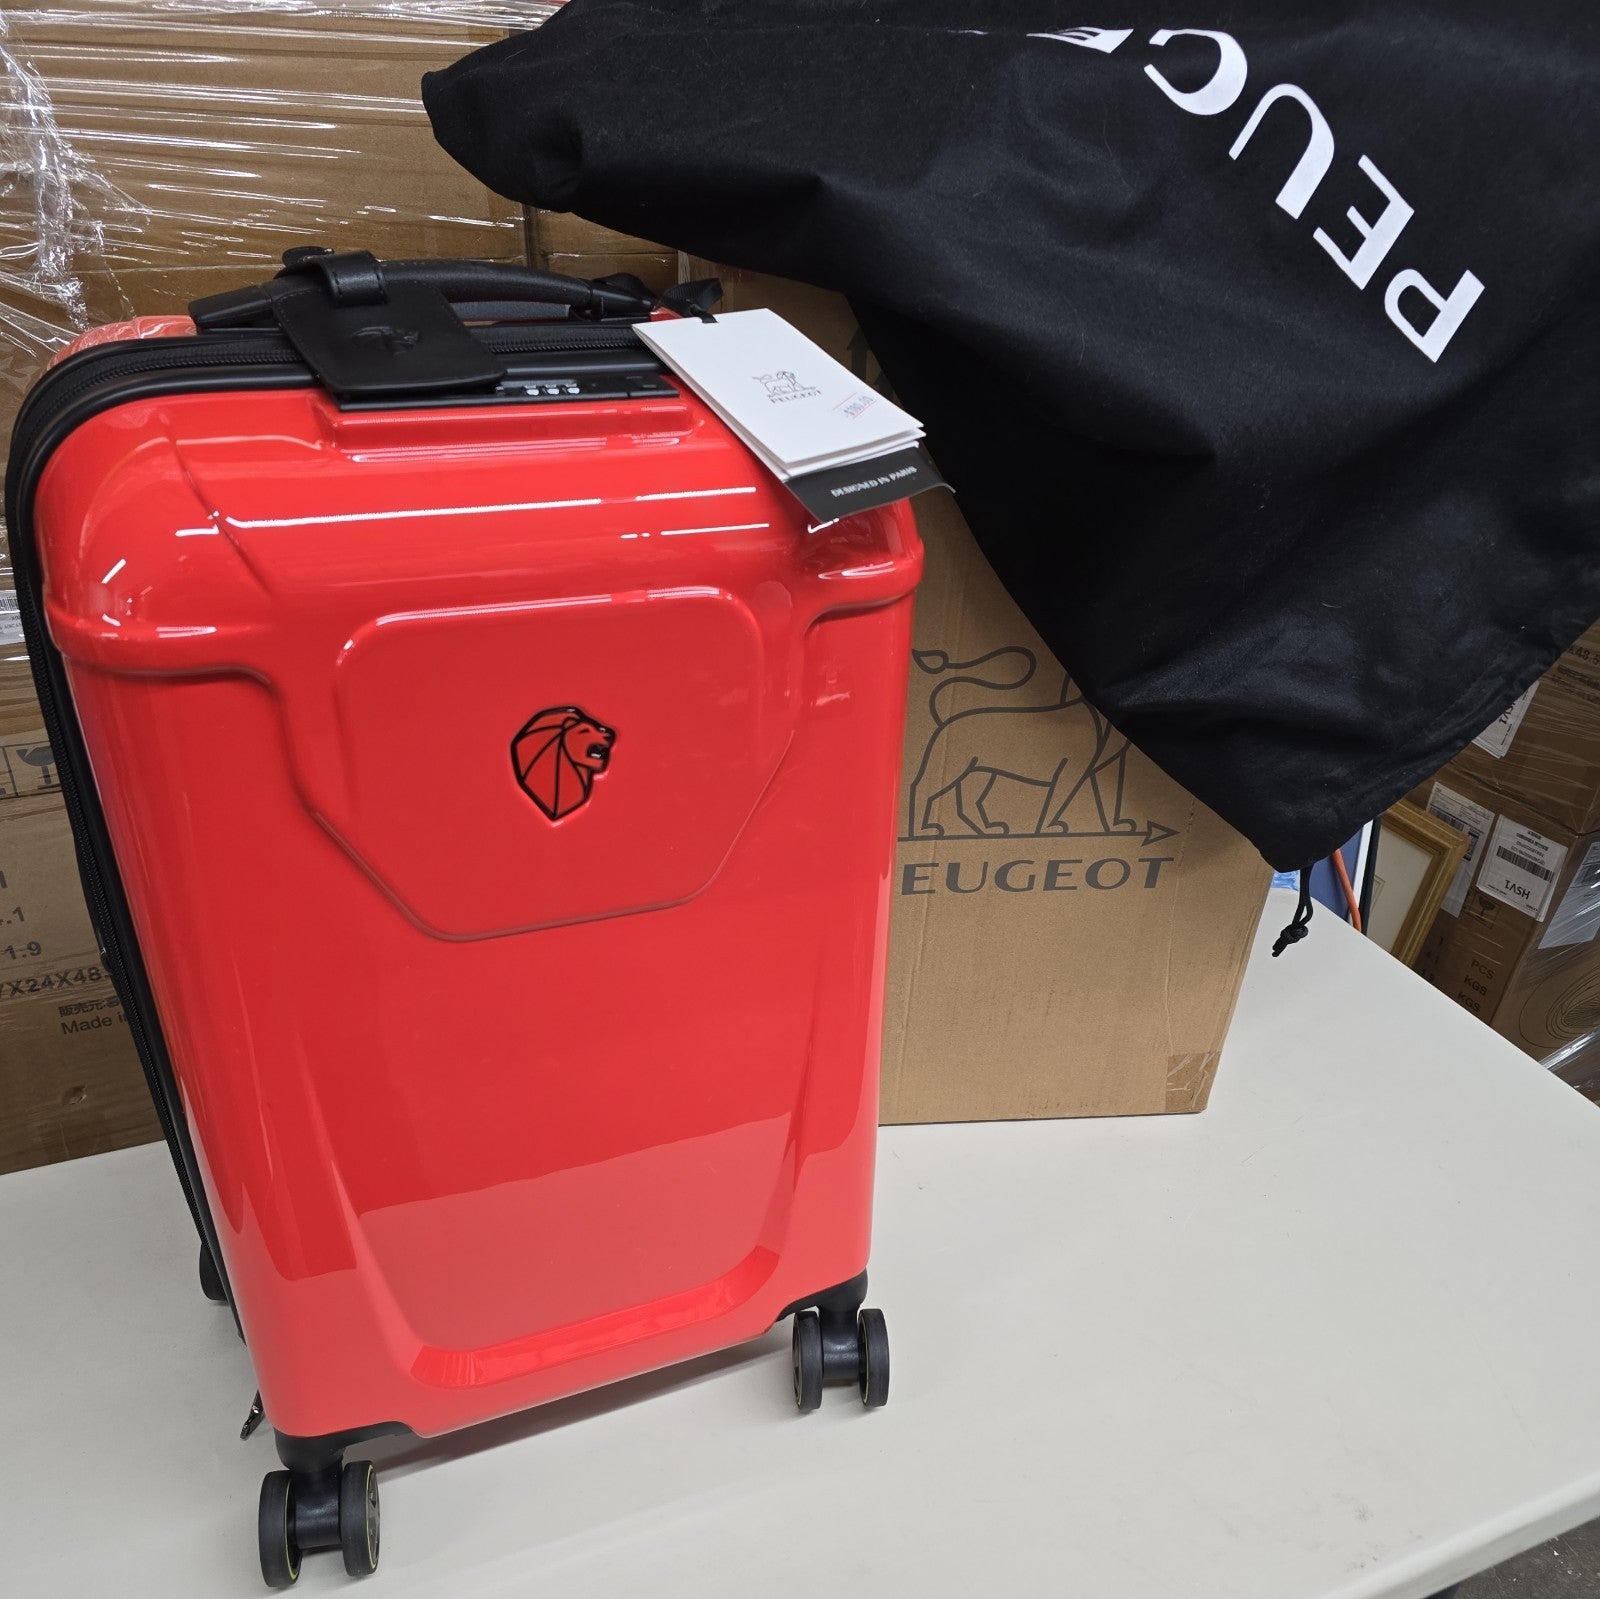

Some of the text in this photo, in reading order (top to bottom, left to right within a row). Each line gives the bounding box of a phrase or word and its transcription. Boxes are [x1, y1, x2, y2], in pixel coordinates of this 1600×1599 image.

[901, 857, 1174, 896] EUGEOT
[1504, 879, 1531, 899] HSV1
[1471, 959, 1494, 979] PCS
[1464, 975, 1487, 996] KGS
[1457, 991, 1480, 1012] KGS
[60, 1014, 113, 1035] Made
